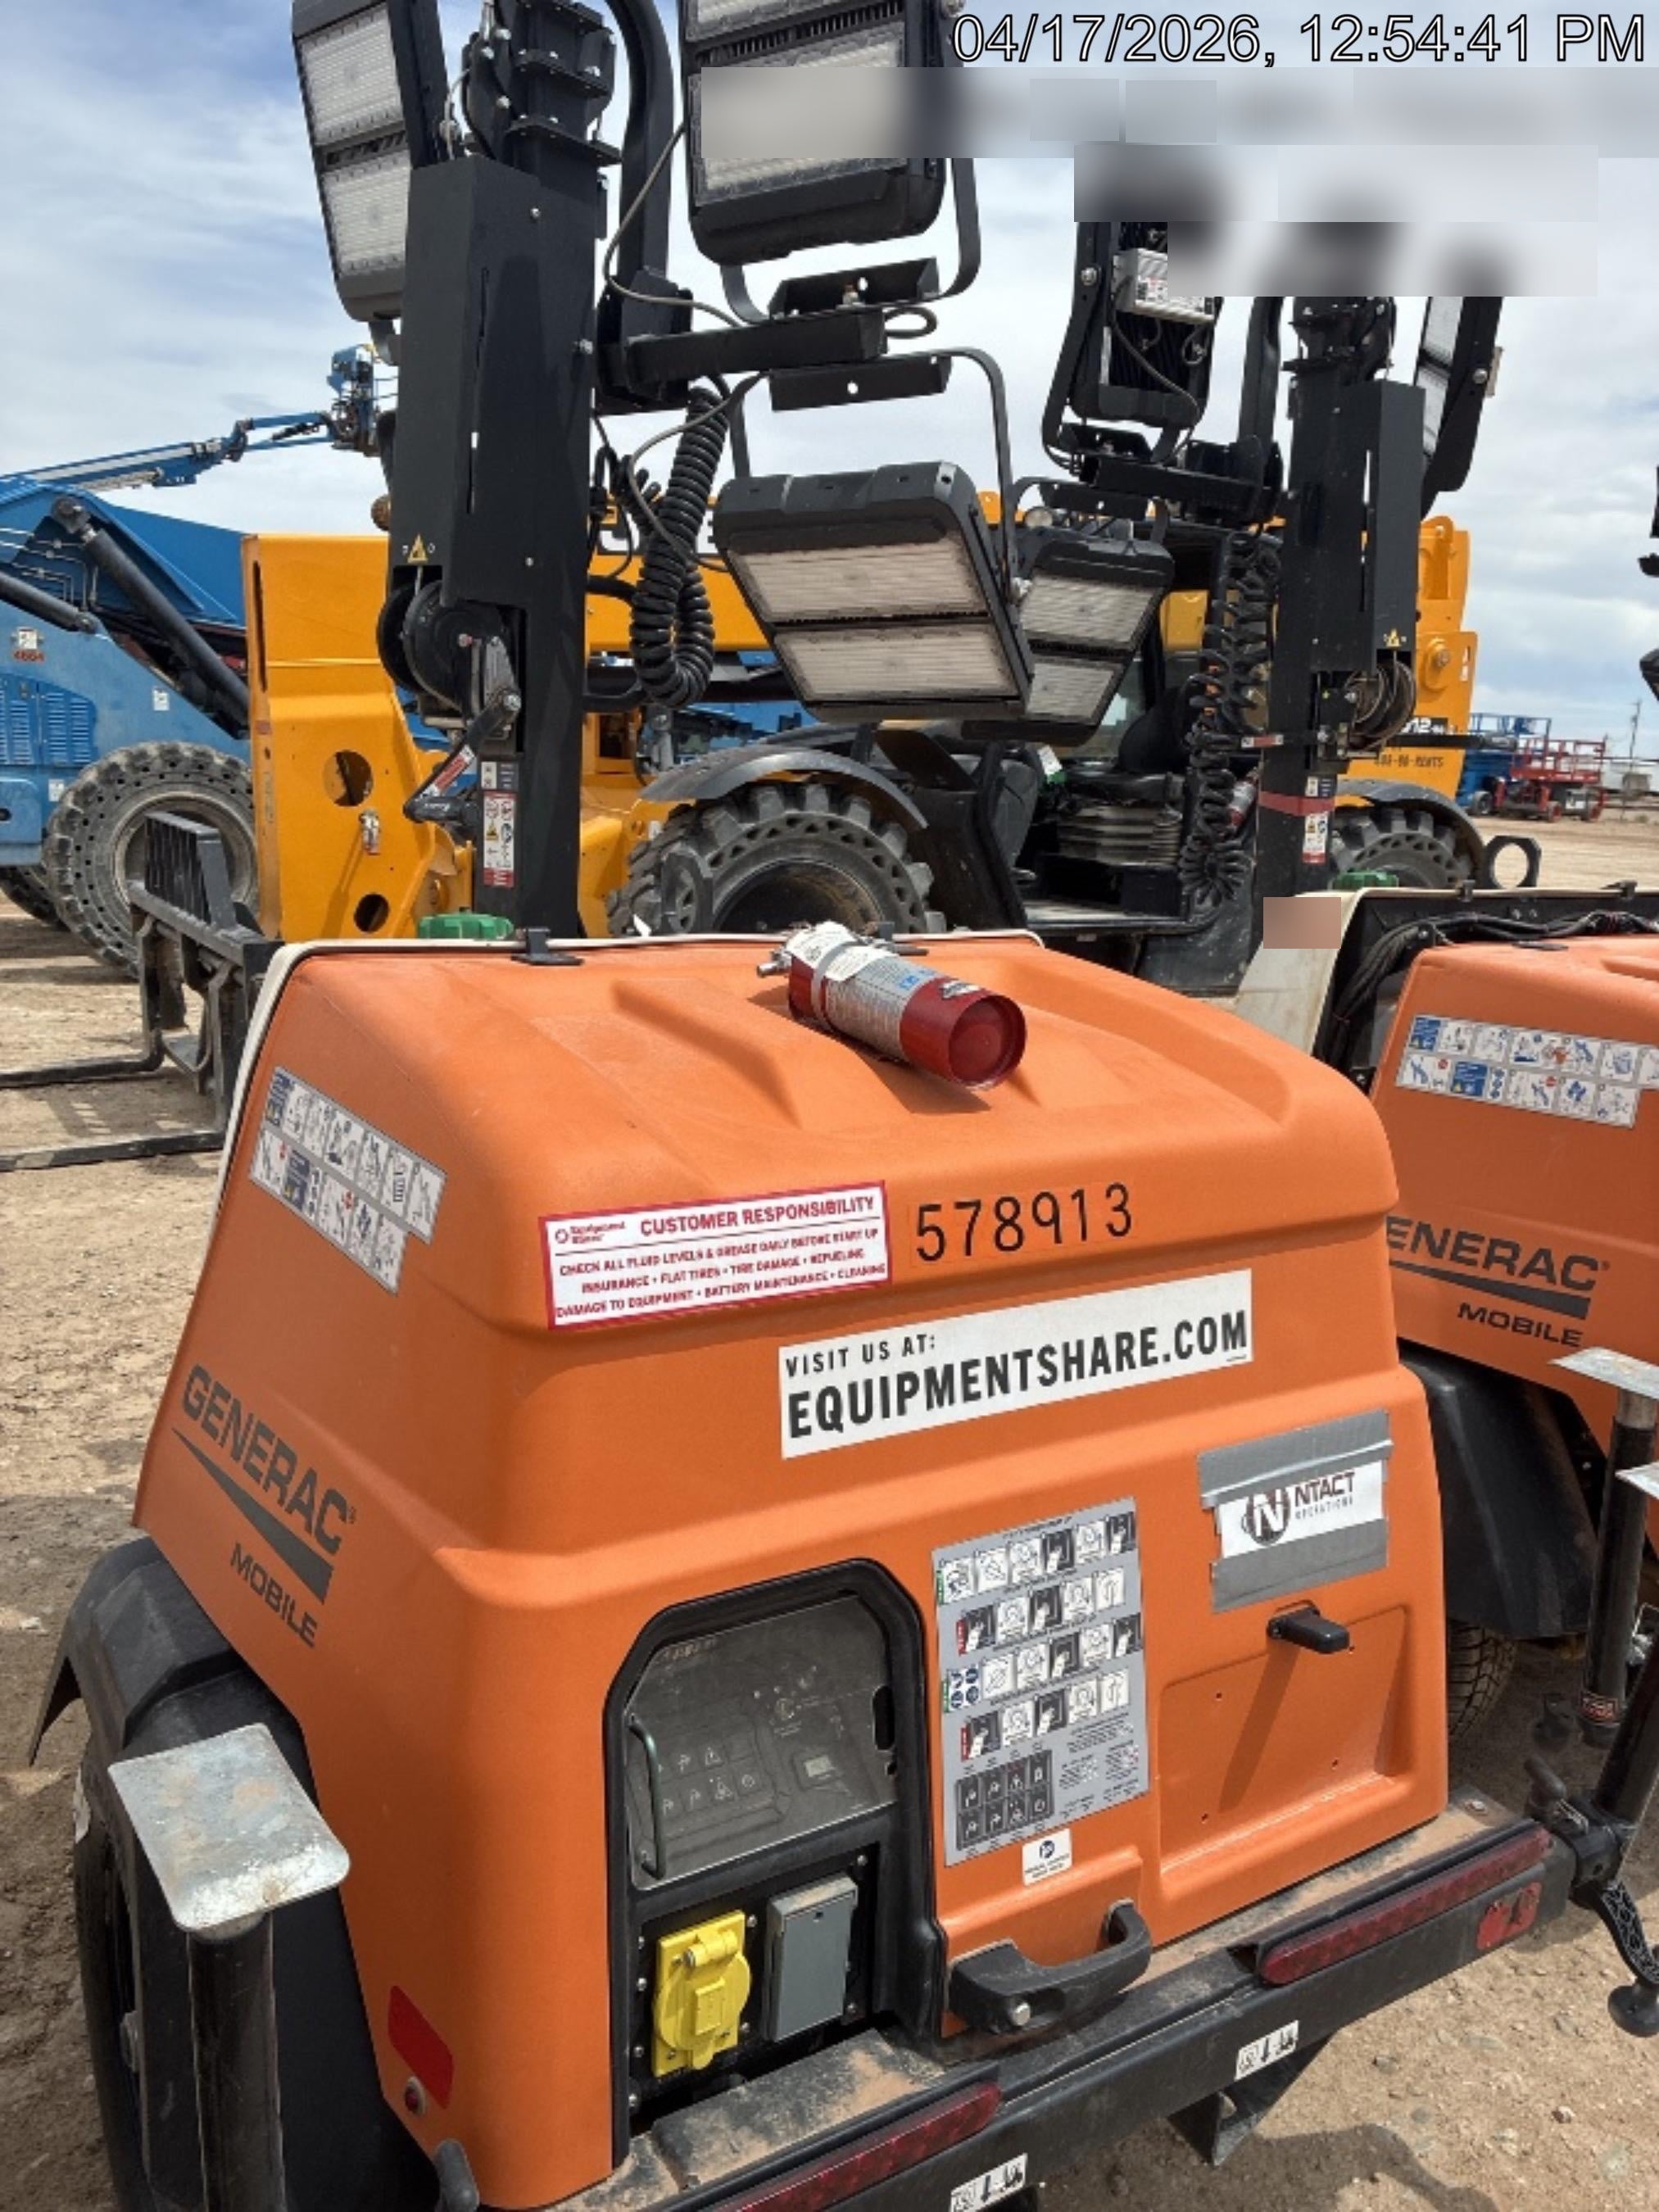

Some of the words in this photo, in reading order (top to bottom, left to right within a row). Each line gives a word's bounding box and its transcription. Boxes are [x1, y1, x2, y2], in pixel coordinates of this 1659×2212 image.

[640, 1210, 738, 1236] CUSTOMER
[741, 1195, 874, 1225] RESPONSIBILITY
[915, 1181, 1133, 1262] 578913
[560, 1260, 600, 1276] CHECK
[604, 1258, 624, 1271] ALL
[627, 1253, 661, 1268] FLUID
[663, 1249, 703, 1264] LEVELS
[706, 1248, 714, 1259] &
[716, 1243, 757, 1258] GREASE
[759, 1238, 790, 1253] DAILY
[791, 1234, 831, 1249] BEFORE
[832, 1229, 863, 1244] START
[864, 1227, 878, 1240] UP
[582, 1275, 650, 1294] INSURANCE
[660, 1271, 687, 1284] FLAT
[689, 1267, 721, 1281] TIRES
[730, 1262, 755, 1276] TIRE
[756, 1256, 800, 1271] DAMAGE
[1385, 1215, 1600, 1292] ENERAC
[556, 1301, 608, 1319] DAMAGE
[610, 1299, 625, 1312] TO
[628, 1290, 694, 1309] EQUIPMENT
[705, 1282, 750, 1299] BATTERY
[754, 1271, 829, 1292] MAINTENANCE
[837, 1262, 886, 1280] CLEANING
[1457, 1302, 1584, 1348] MOBILE
[785, 1347, 849, 1379] VISIT
[861, 1341, 891, 1366] US
[901, 1334, 936, 1358] AT:
[787, 1310, 1248, 1439] EQUIPMENTSHARE.COM
[181, 1362, 349, 1556] GENERAC
[1294, 1471, 1356, 1508] NTACT
[230, 1542, 318, 1649] MOBILE
